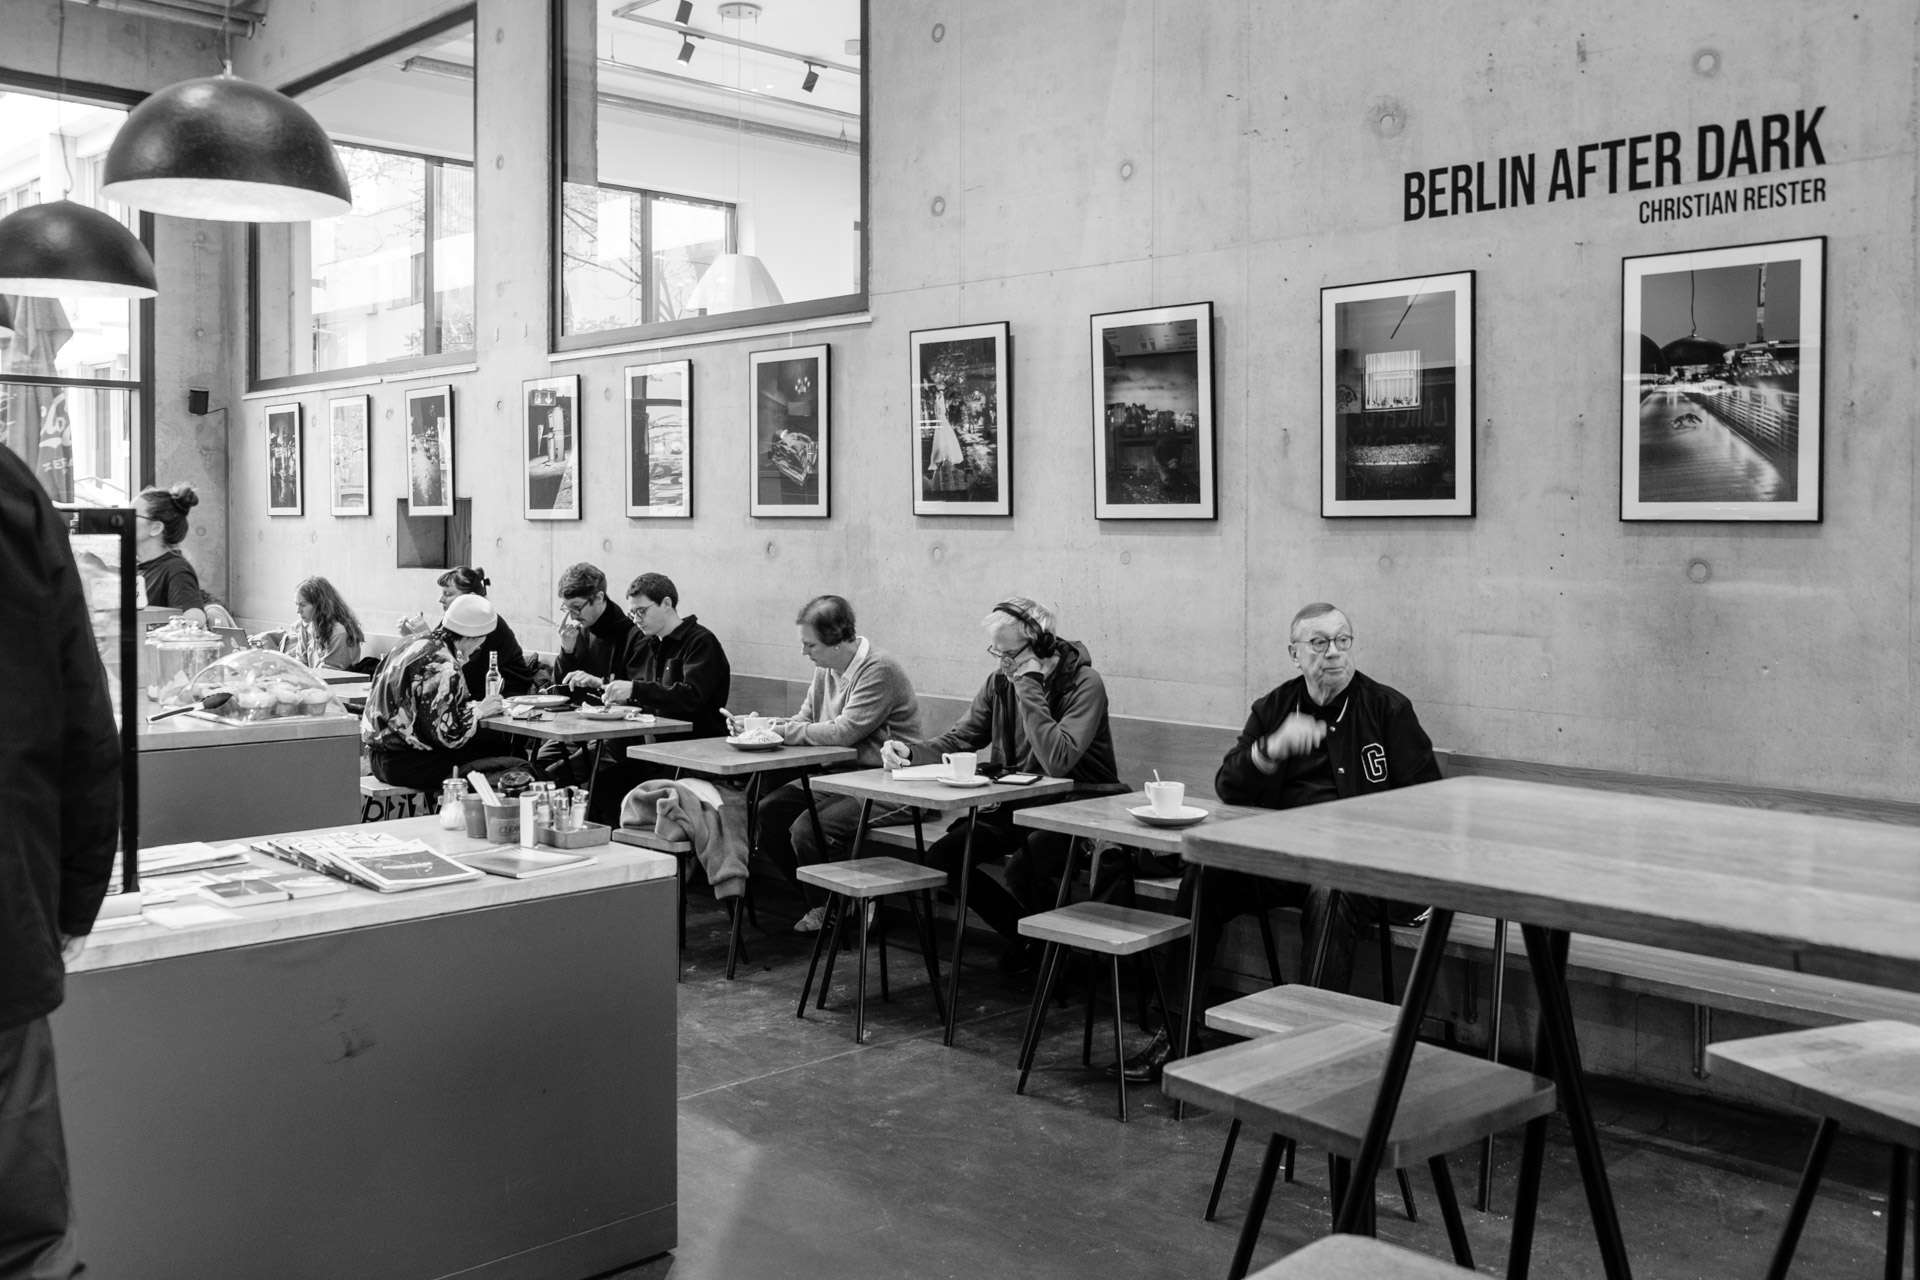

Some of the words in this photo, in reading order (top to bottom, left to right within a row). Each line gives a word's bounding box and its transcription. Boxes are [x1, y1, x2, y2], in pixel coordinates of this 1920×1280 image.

[1404, 153, 1535, 222] BERLIN
[1548, 131, 1682, 203] AFTER
[1697, 106, 1826, 182] DARK
[1639, 189, 1737, 224] CHRISTIAN
[1743, 177, 1826, 211] REISTER
[1361, 743, 1388, 783] G
